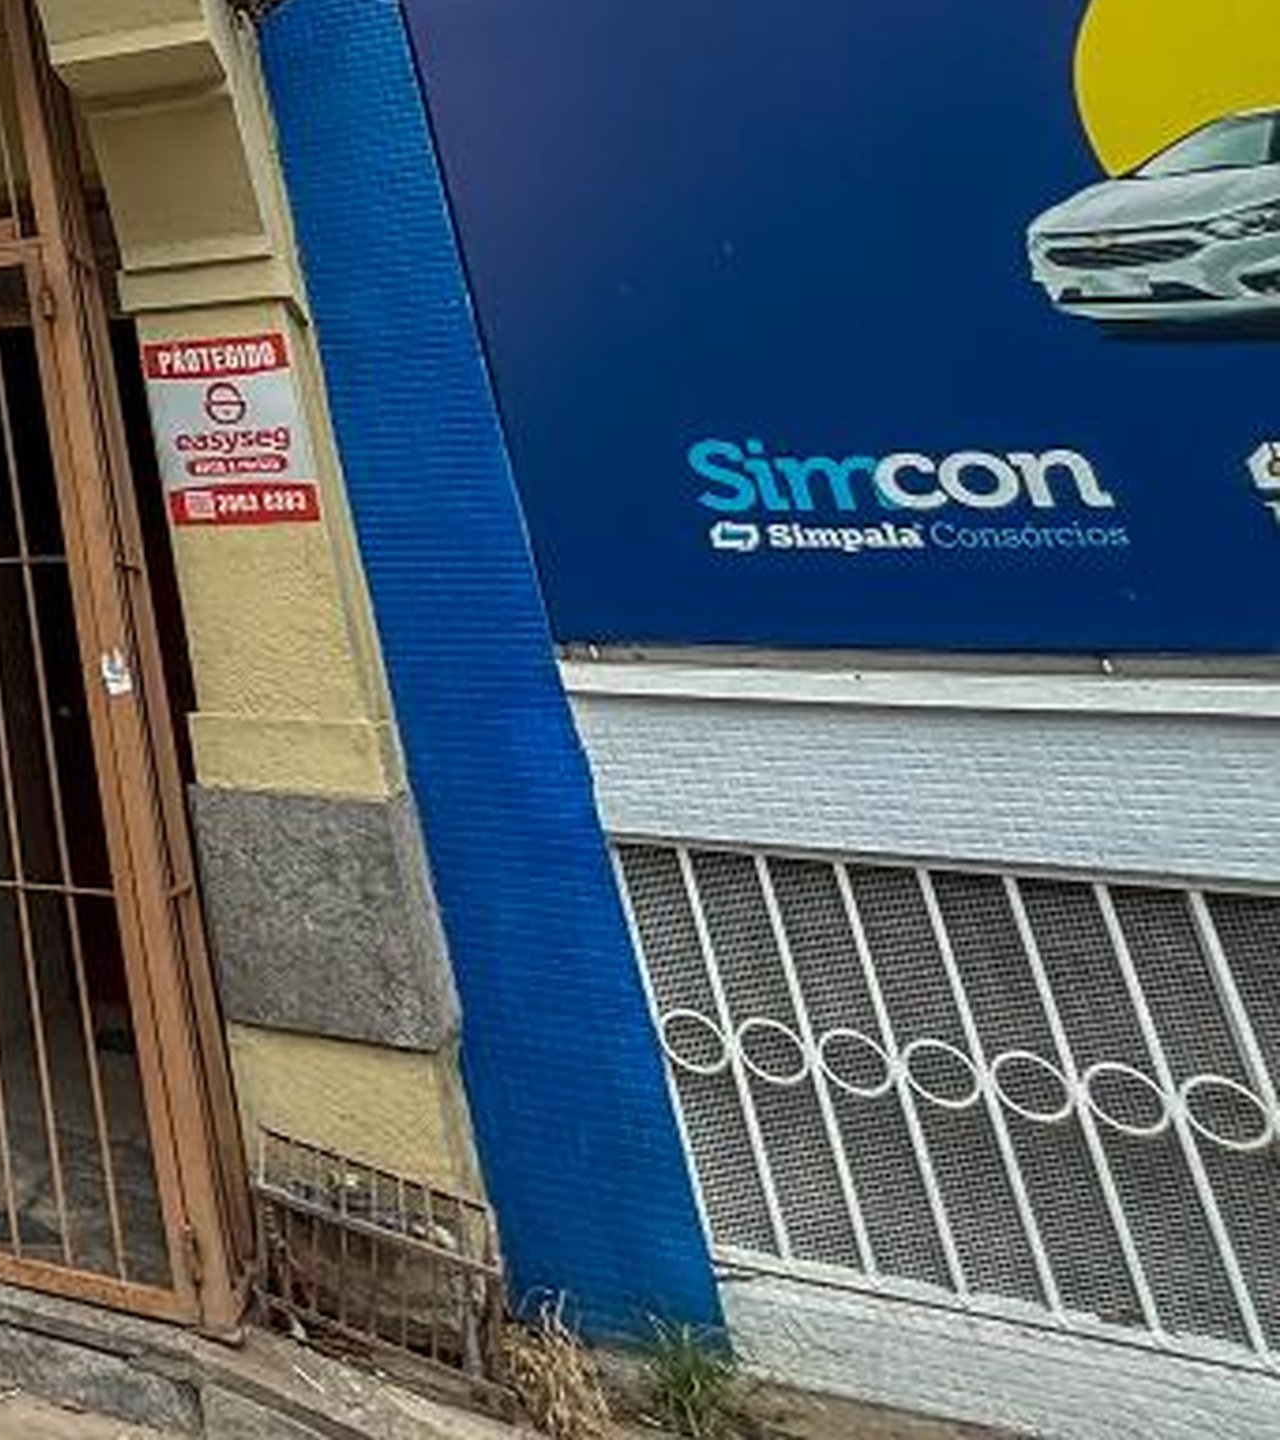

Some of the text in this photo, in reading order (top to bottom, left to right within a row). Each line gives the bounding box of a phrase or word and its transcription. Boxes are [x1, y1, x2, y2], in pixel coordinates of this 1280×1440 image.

[156, 340, 277, 375] PROTEGIDO
[175, 427, 292, 453] easyseg
[686, 437, 1116, 511] Simcon
[766, 519, 1132, 553] Simpala Consórcios
